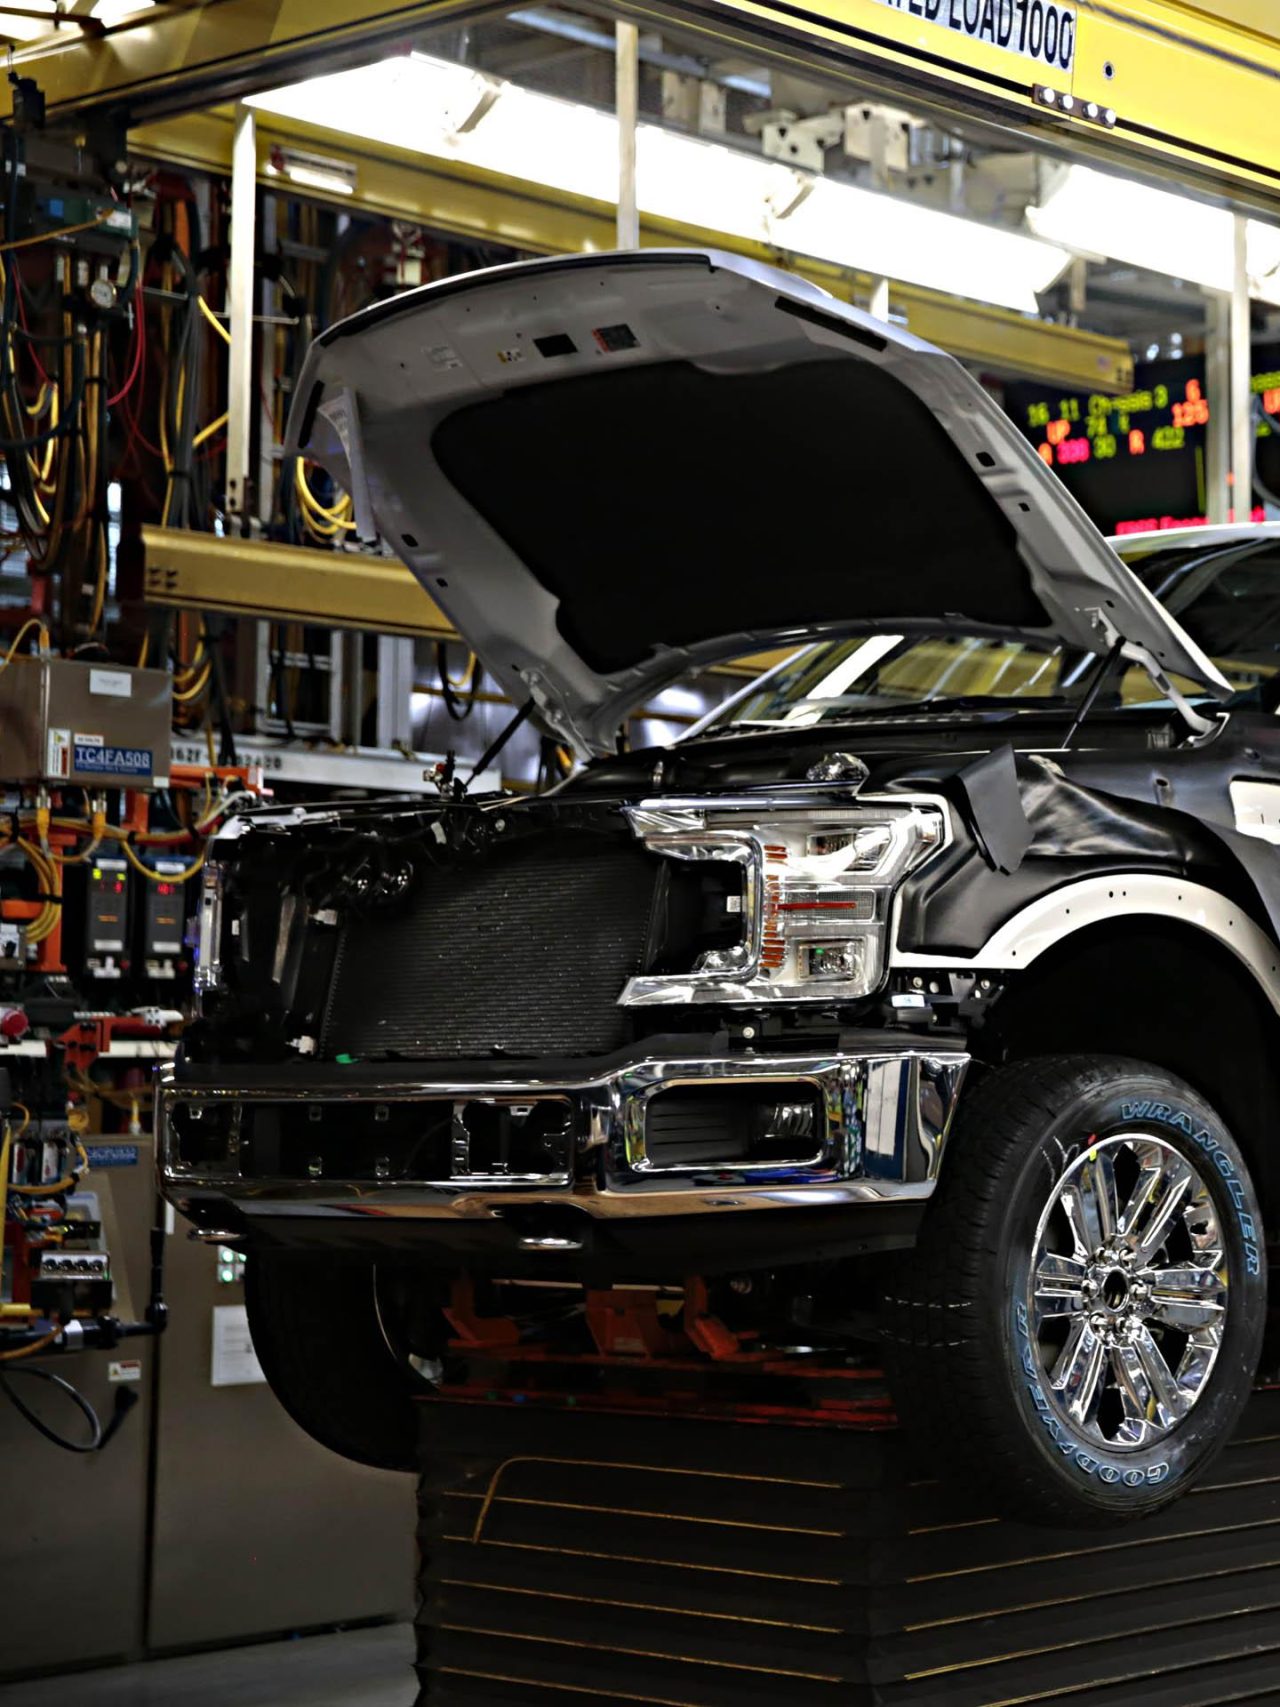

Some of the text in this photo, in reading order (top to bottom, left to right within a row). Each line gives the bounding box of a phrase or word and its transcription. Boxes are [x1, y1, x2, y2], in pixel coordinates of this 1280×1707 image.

[949, 0, 1074, 69] LOAD 1000
[1121, 1101, 1260, 1276] WRANGLER
[1016, 1303, 1169, 1487] GOODYEAR
